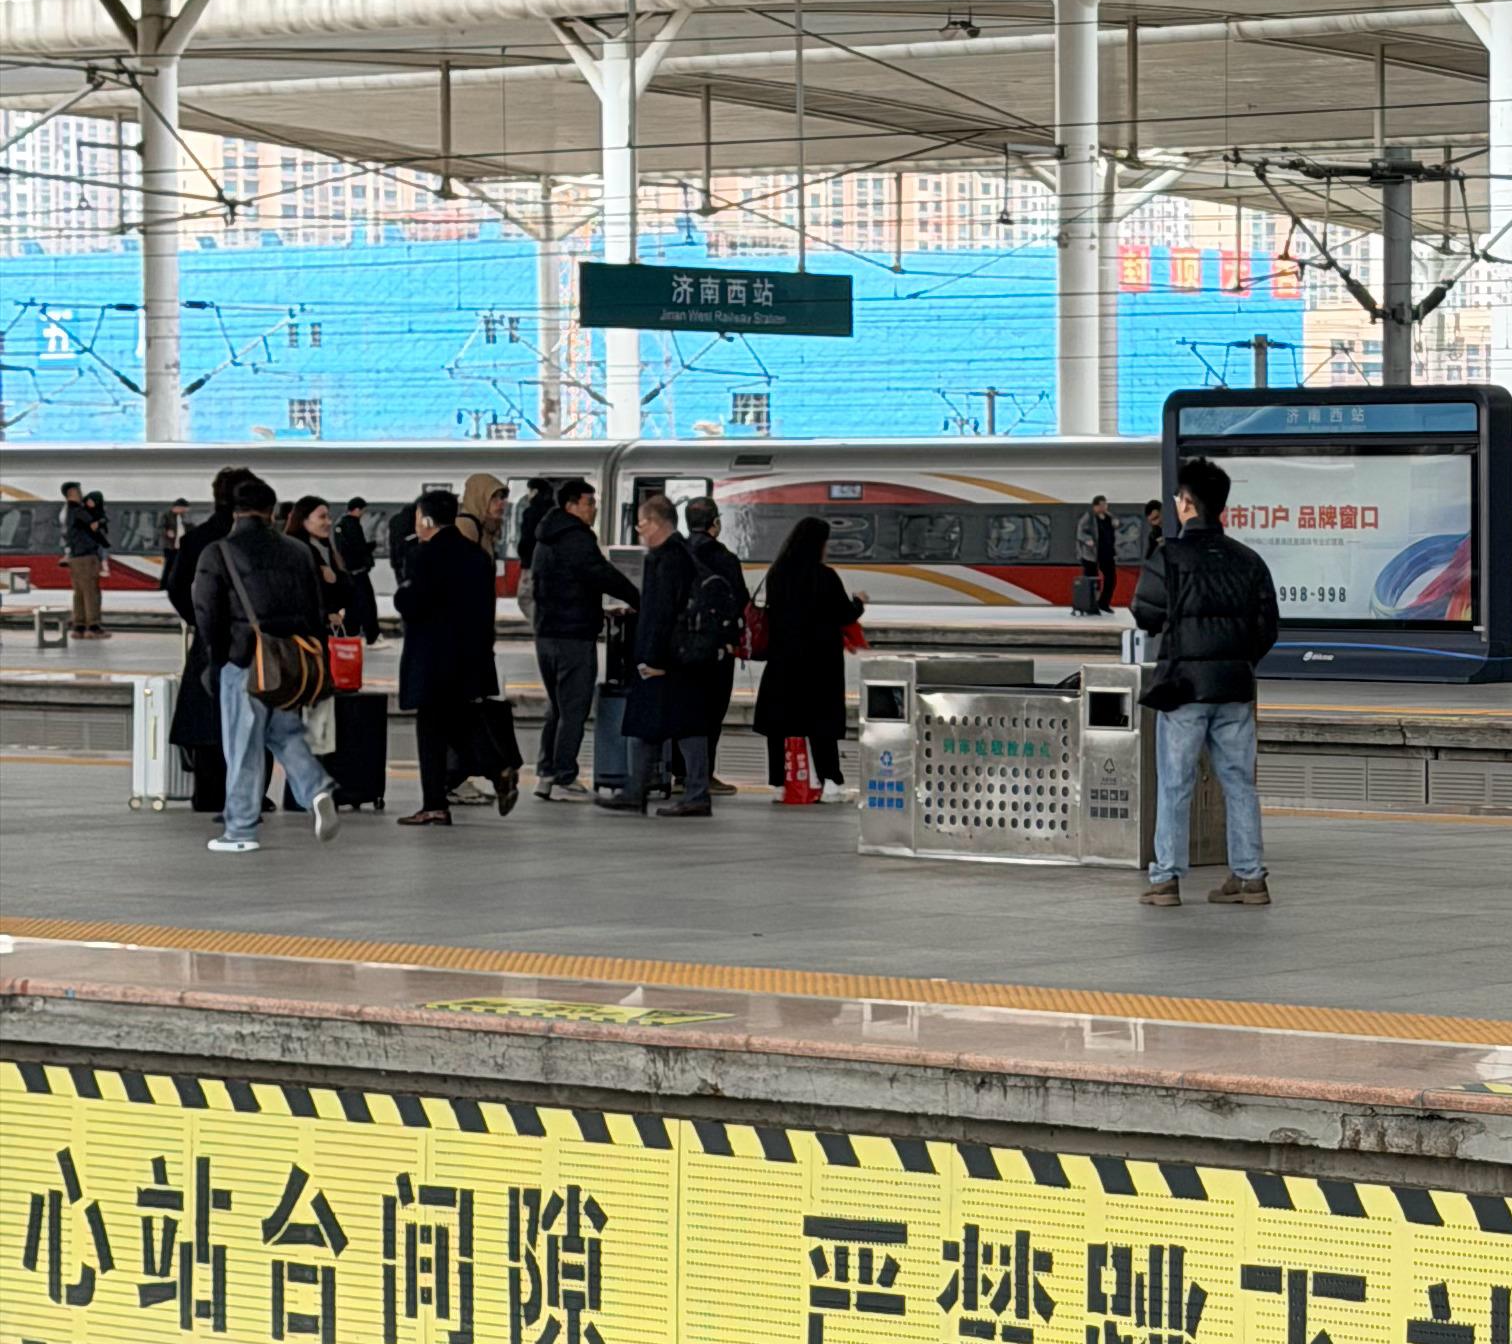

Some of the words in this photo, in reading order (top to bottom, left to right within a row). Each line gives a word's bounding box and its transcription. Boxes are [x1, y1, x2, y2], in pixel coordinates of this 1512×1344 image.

[672, 274, 775, 307] 济南西站
[1286, 407, 1365, 424] 济南西站
[1298, 505, 1379, 529] 品牌窗口
[1279, 586, 1347, 603] 998-998
